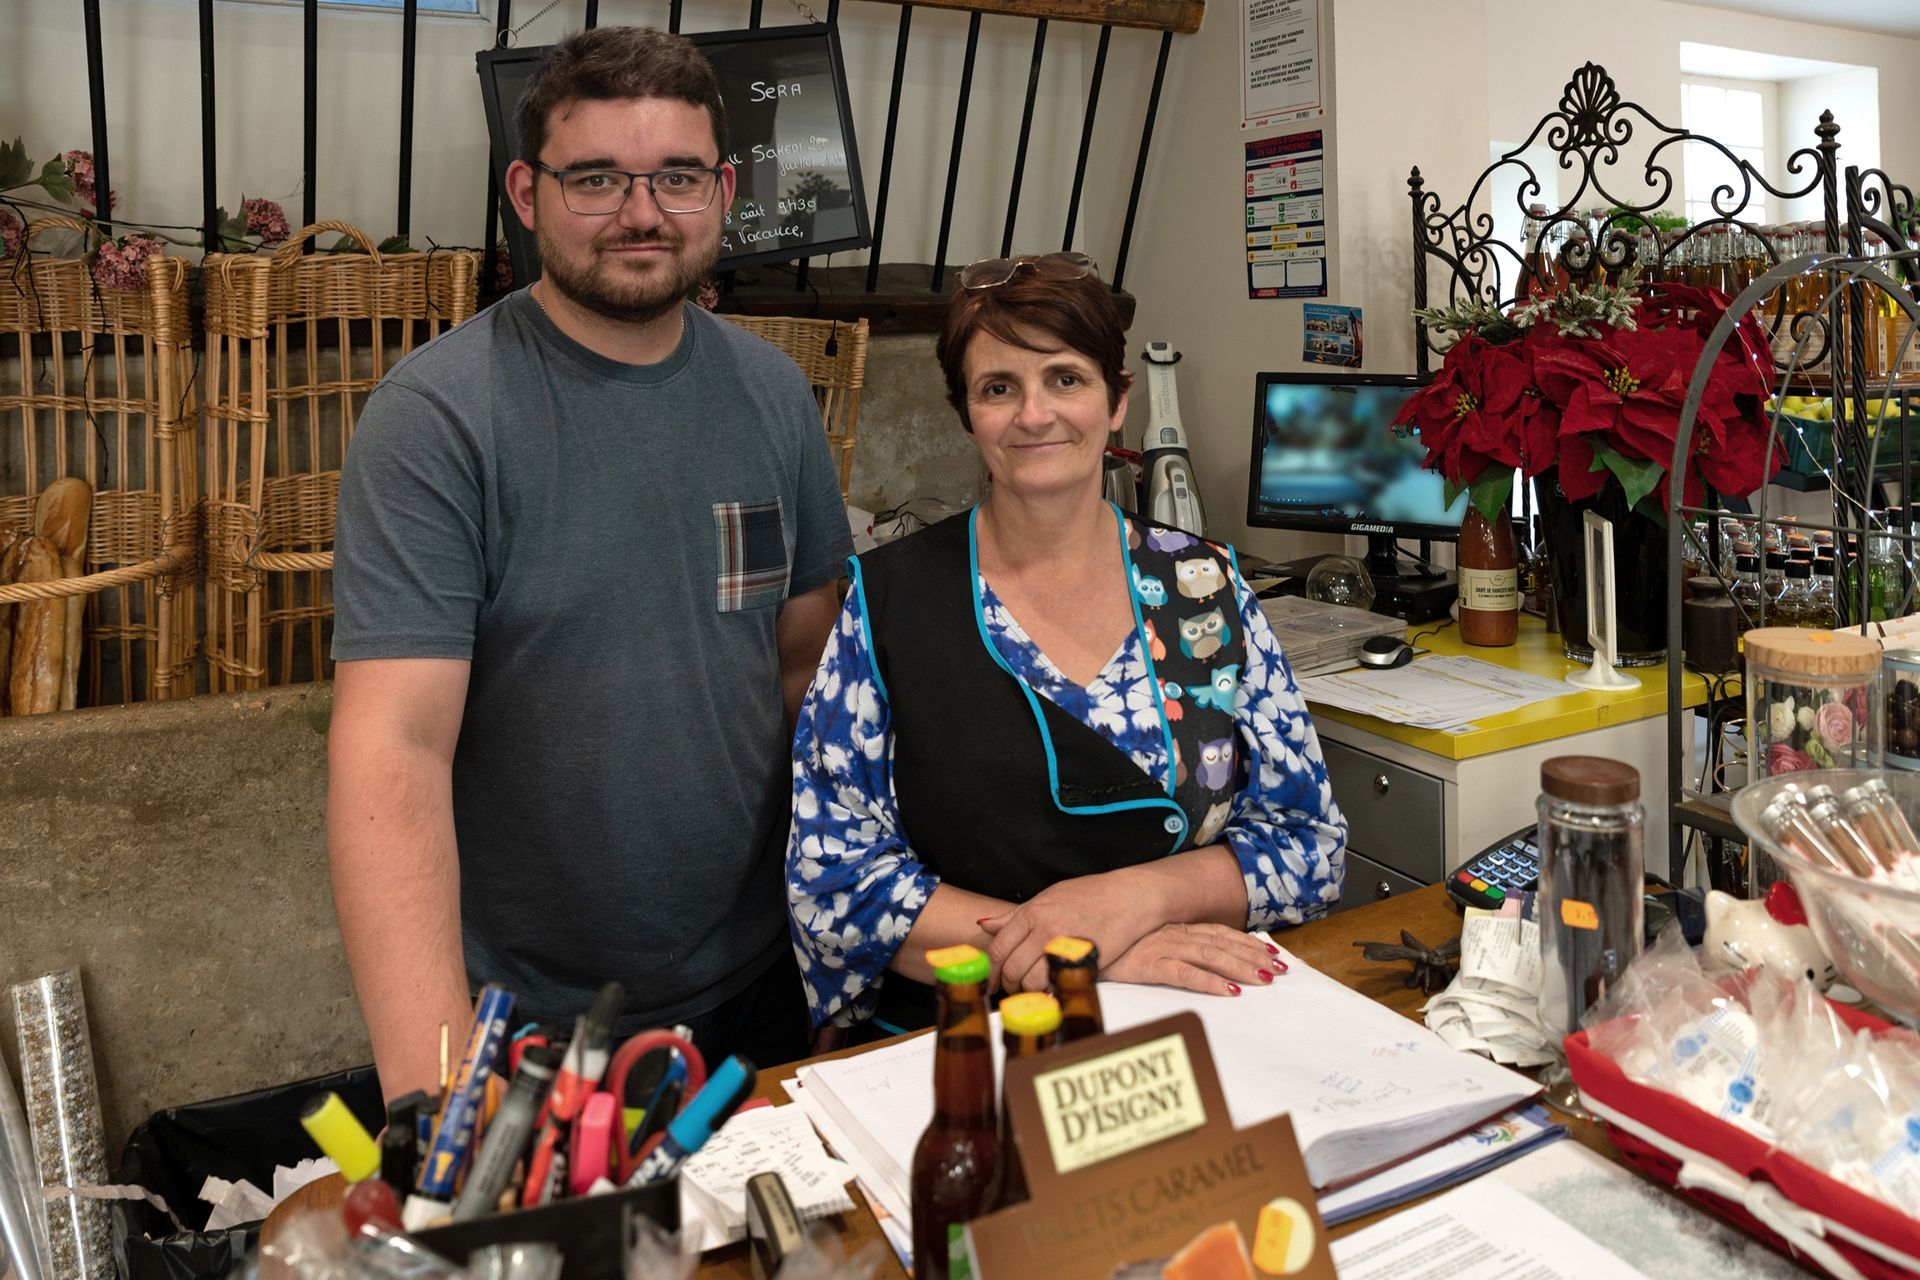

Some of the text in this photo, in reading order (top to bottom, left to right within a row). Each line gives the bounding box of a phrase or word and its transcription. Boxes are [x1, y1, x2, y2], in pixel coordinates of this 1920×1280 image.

[1350, 523, 1394, 534] GIGAMEDIA
[1051, 1048, 1176, 1112] DUPONT
[1059, 1077, 1185, 1146] D'ISIGNY
[1129, 1141, 1265, 1216] CARAMEL
